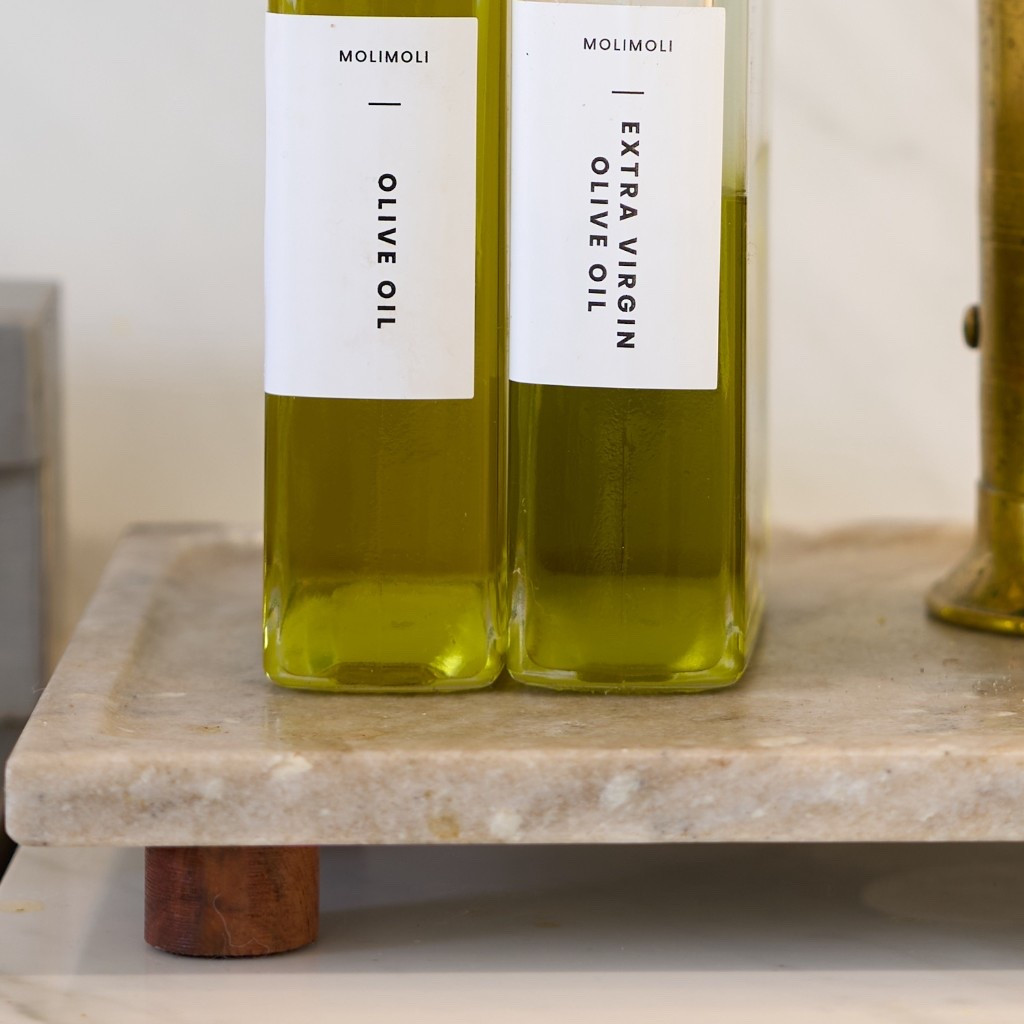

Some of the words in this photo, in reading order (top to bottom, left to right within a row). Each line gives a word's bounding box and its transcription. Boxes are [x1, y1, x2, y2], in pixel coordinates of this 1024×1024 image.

[339, 50, 430, 64] MOLIMOLI
[584, 37, 674, 53] MOLIMOLI
[589, 157, 609, 247] OLIVE
[619, 122, 640, 221] EXTRA
[377, 174, 397, 264] OLIVE
[377, 281, 397, 329] OIL
[587, 264, 607, 312] OIL
[616, 238, 637, 349] VIRGIN
